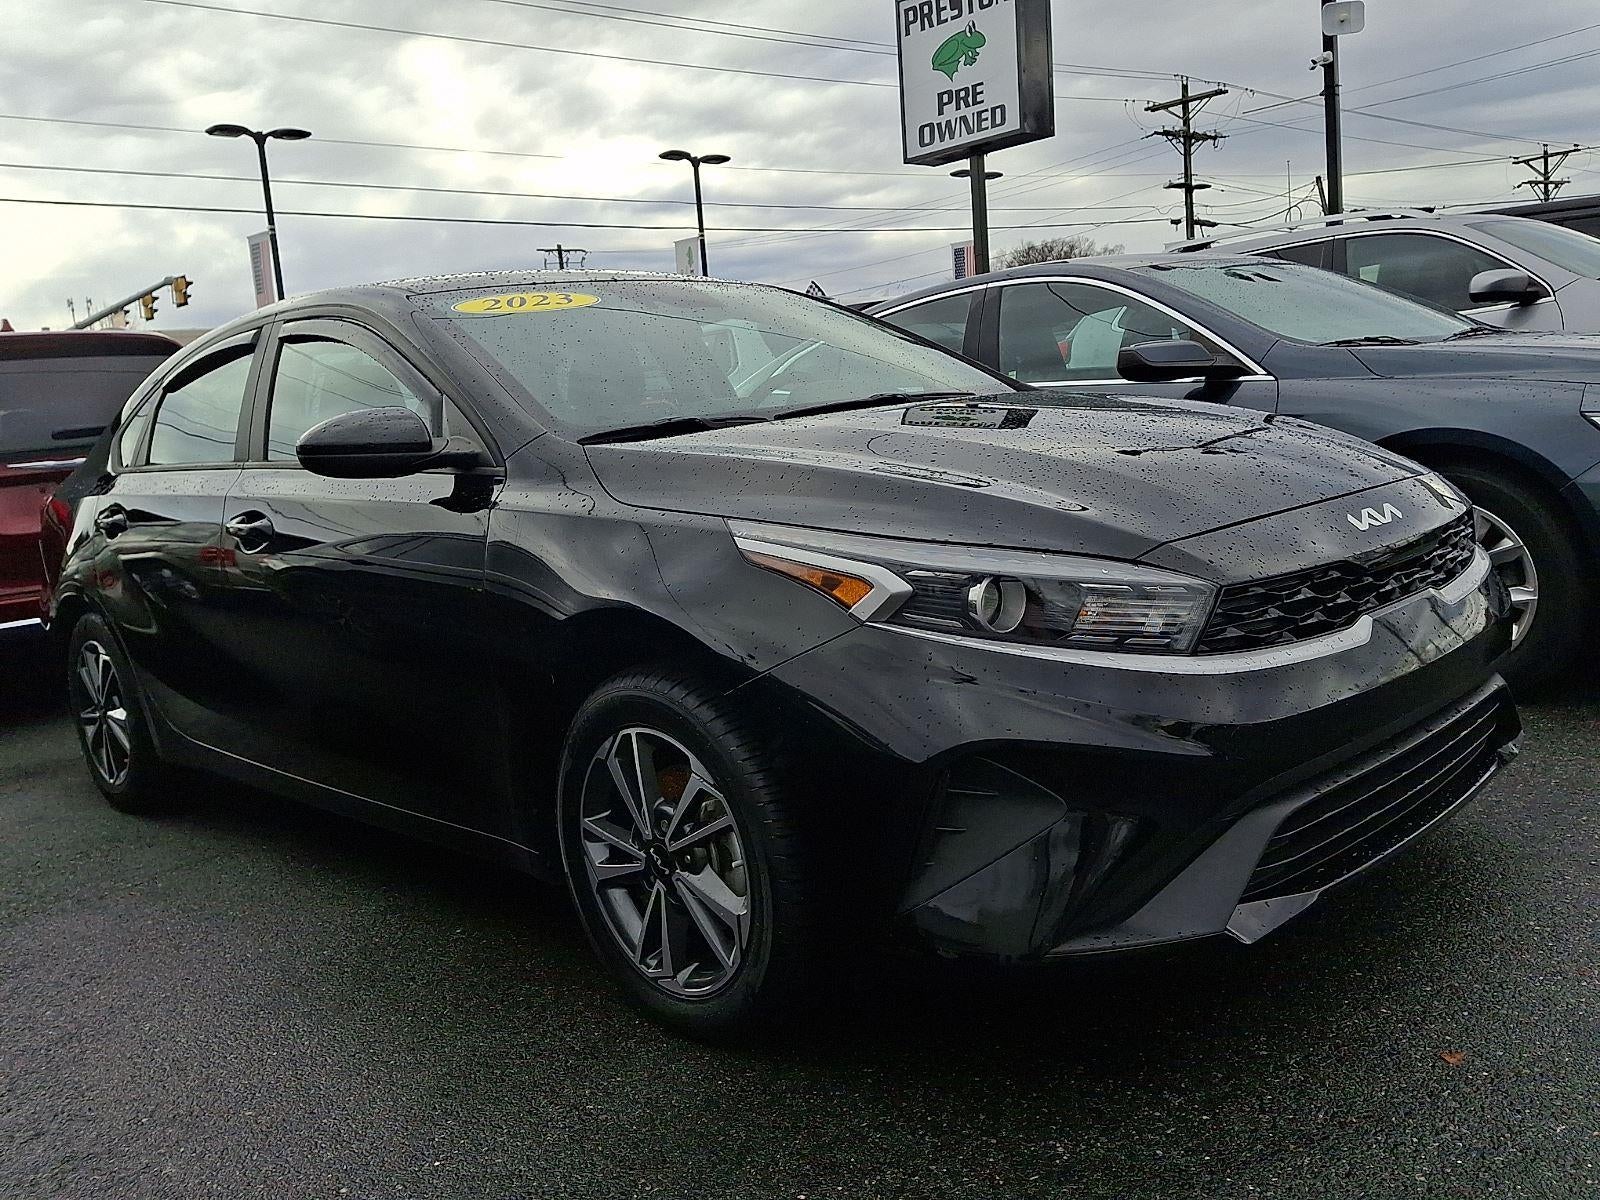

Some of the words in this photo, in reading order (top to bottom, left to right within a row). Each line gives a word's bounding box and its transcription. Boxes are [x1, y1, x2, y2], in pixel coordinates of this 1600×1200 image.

[903, 0, 1008, 37] PREST
[937, 81, 985, 117] PRE
[918, 103, 1007, 148] OWNED
[482, 293, 573, 311] 2023
[1346, 502, 1403, 531] KIA
